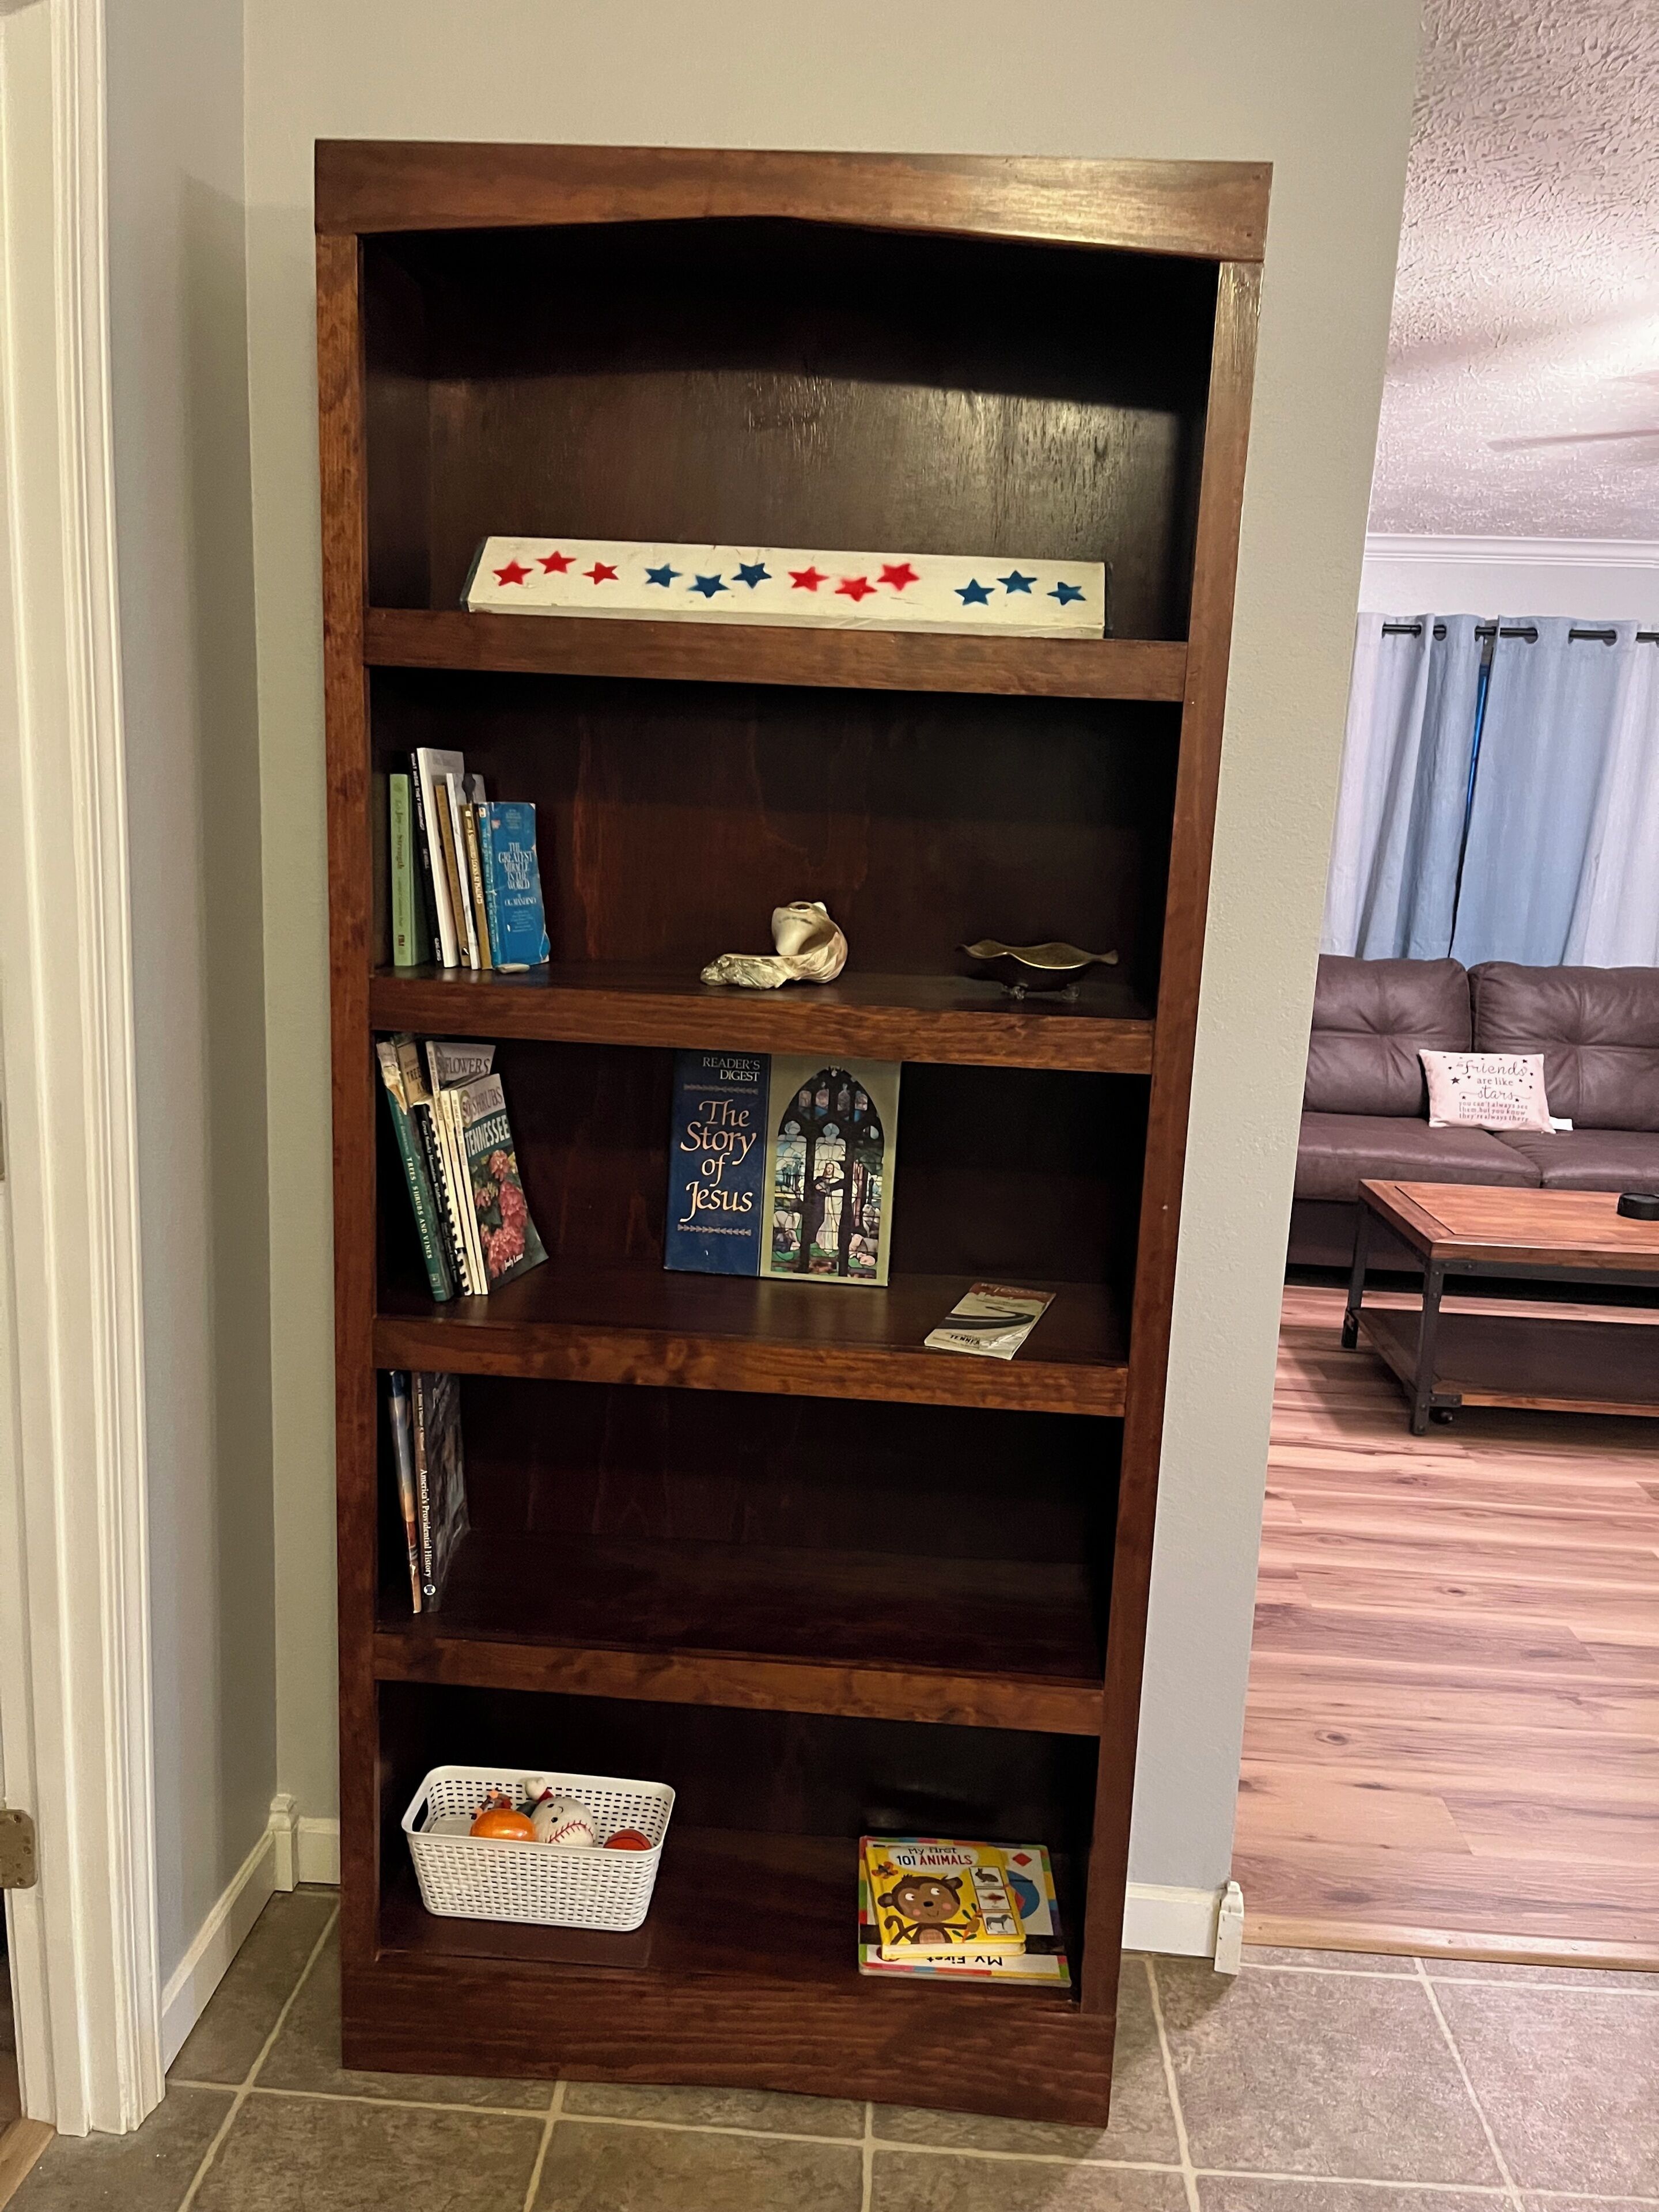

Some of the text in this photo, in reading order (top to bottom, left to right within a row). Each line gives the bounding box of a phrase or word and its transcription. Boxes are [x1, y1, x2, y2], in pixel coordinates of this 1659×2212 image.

[498, 851, 532, 863] GREATEST
[507, 880, 530, 889] WORLD
[445, 1057, 490, 1074] FLOWERS
[703, 1057, 760, 1070] READER'S
[720, 1070, 760, 1082] DIGEST
[1495, 1077, 1513, 1086] like
[1473, 1085, 1518, 1100] stars
[472, 1086, 503, 1116] SHRUBS
[699, 1099, 750, 1127] The
[464, 1115, 510, 1158] TENNESSEE
[680, 1121, 757, 1165] Story
[702, 1152, 730, 1187] of
[411, 1185, 424, 1215] SHRUBS
[679, 1181, 753, 1223] Jesus
[418, 1217, 427, 1233] AND
[422, 1235, 433, 1259] VINES
[421, 1469, 432, 1578] America's Providential History
[908, 1847, 924, 1855] My
[896, 1854, 973, 1866] 101 ANIMALS
[975, 1956, 1003, 1966] My
